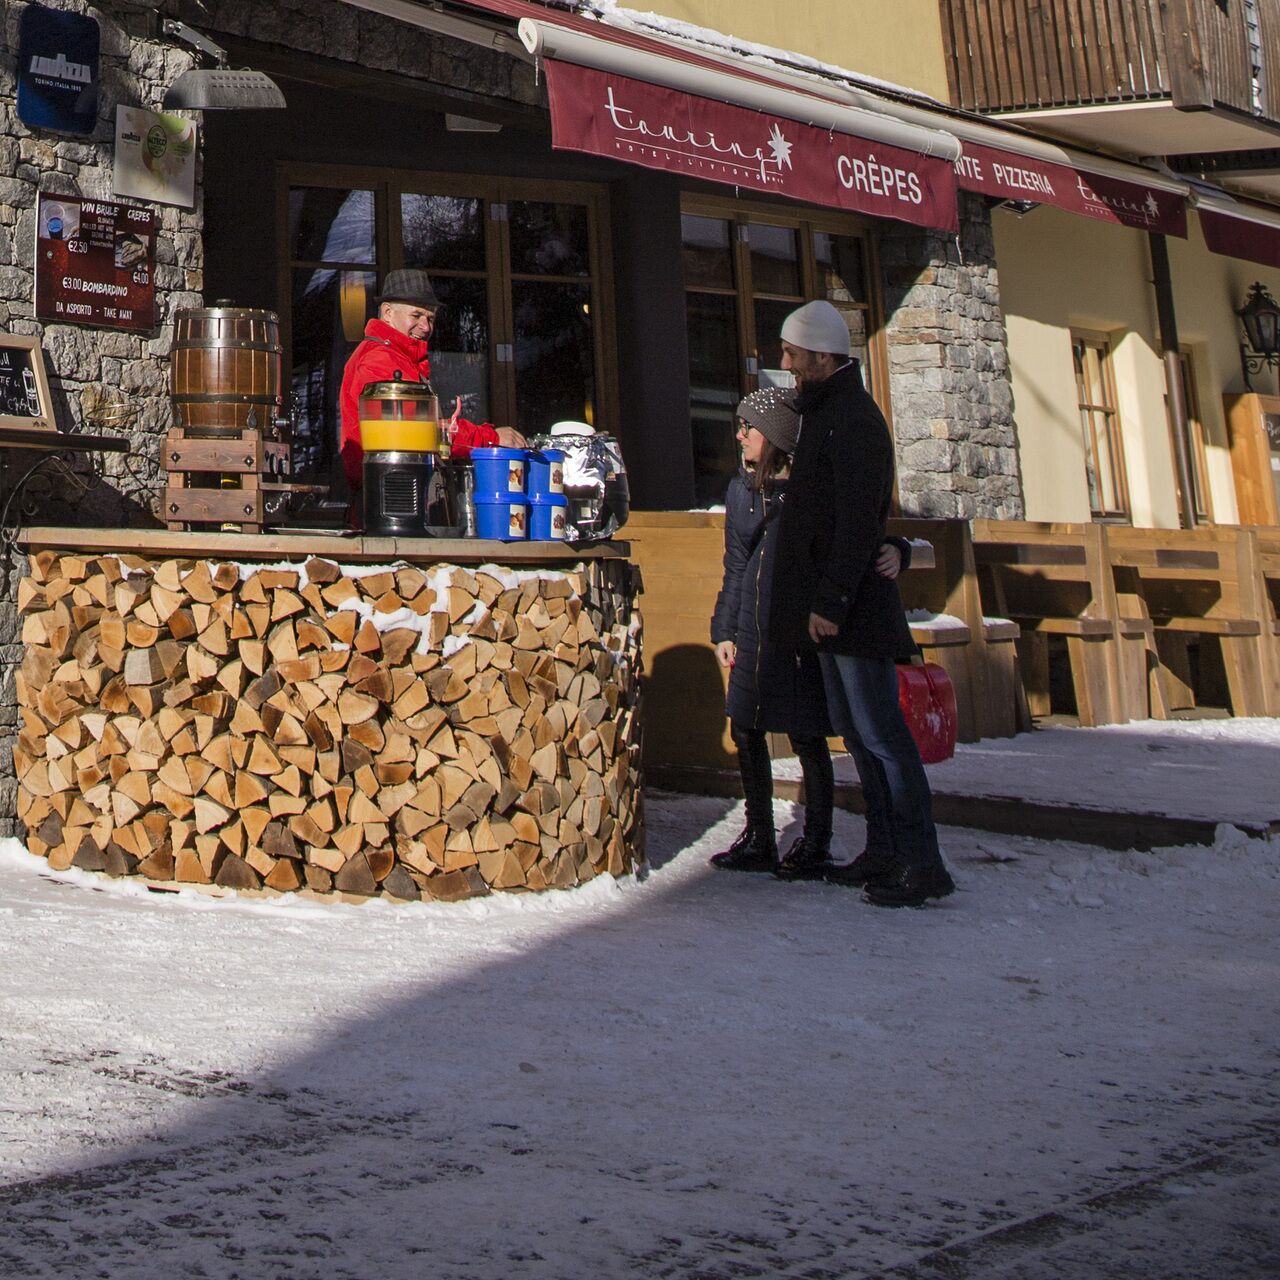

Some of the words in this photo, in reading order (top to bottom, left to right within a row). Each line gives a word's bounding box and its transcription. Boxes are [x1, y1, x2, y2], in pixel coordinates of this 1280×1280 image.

[837, 152, 923, 206] CRÊPES
[992, 163, 1056, 196] PIZZERIA
[81, 202, 95, 214] VIN
[127, 209, 151, 222] CREPES
[68, 240, 88, 253] €2.50
[62, 277, 81, 290] €3.00
[82, 281, 128, 296] BOMBARDINO
[56, 302, 64, 313] DA
[66, 302, 92, 316] ASPORTO
[104, 307, 117, 319] TAKE
